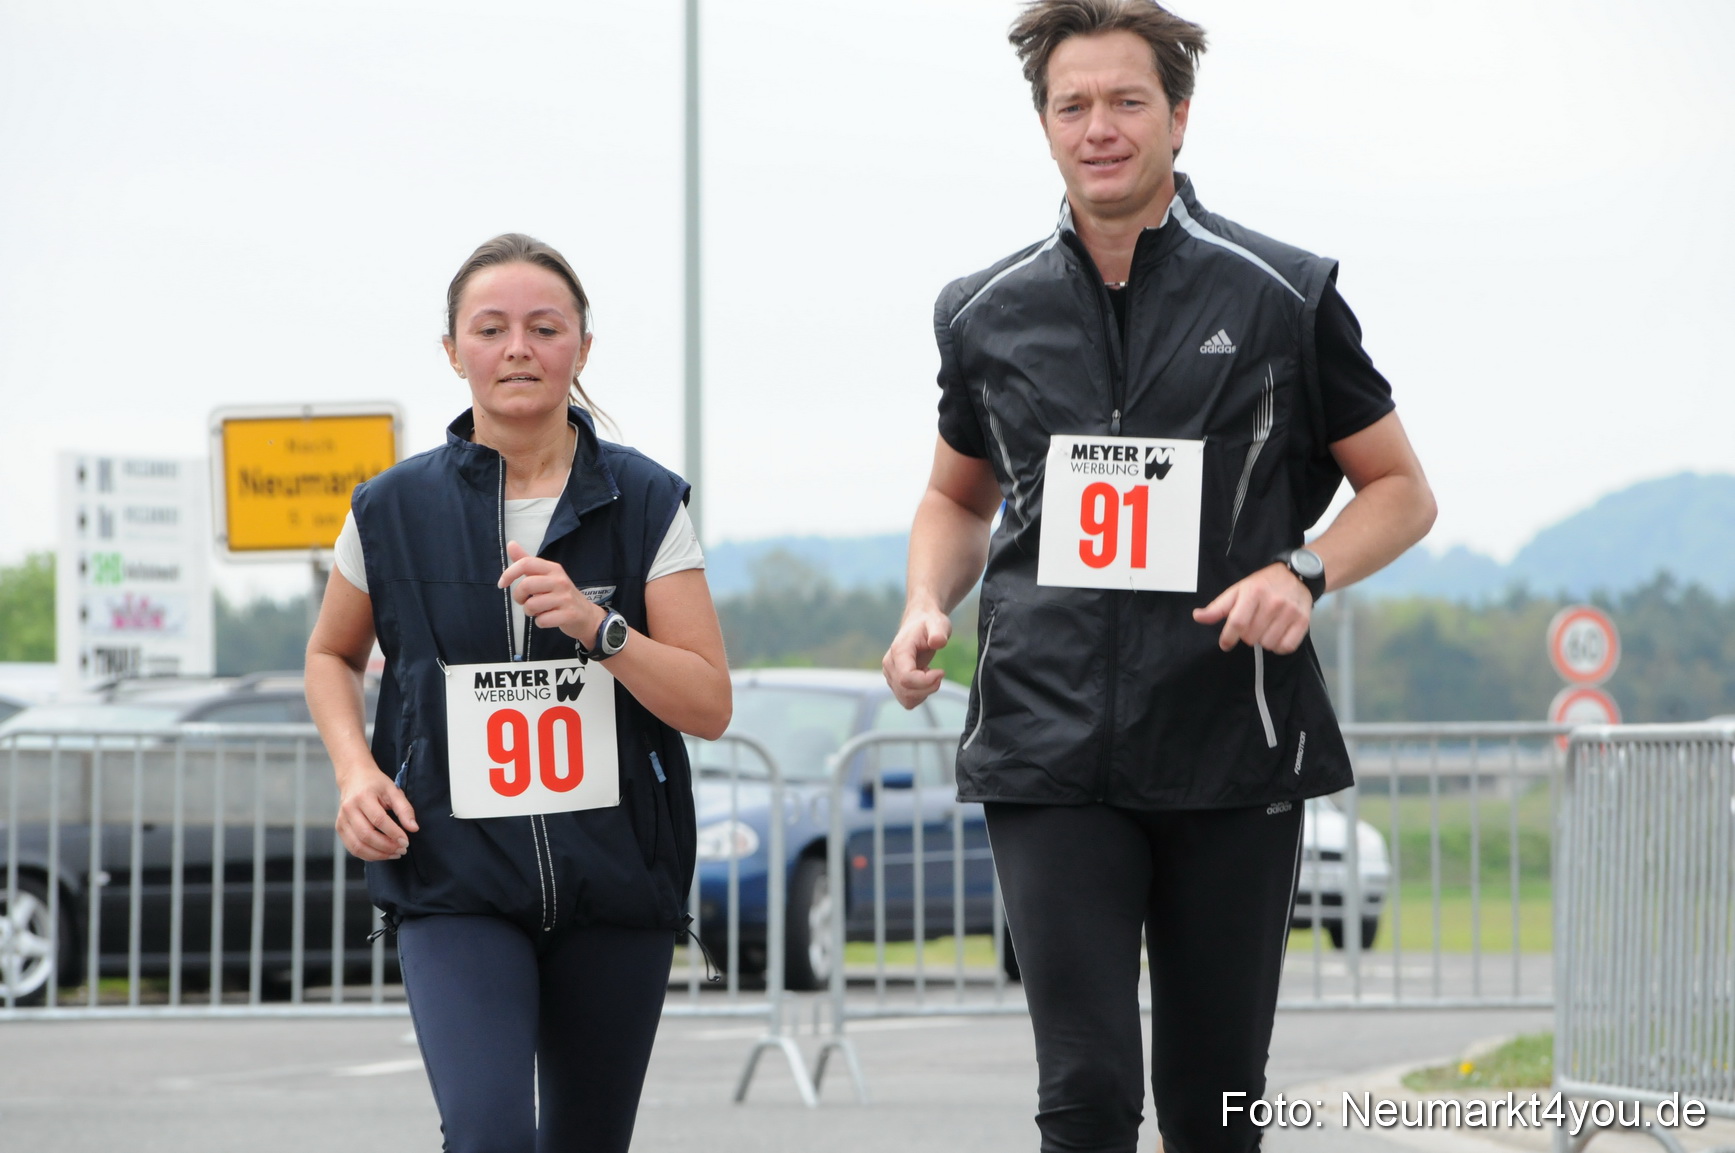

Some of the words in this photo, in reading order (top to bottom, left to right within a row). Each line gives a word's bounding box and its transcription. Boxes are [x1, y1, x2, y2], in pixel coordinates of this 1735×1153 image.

[1071, 443, 1139, 462] MEYER
[1071, 461, 1139, 476] WERBUNG
[1079, 481, 1149, 569] 91
[474, 669, 549, 689] MEYER
[474, 687, 551, 702] WERBUNG
[487, 706, 584, 797] 90
